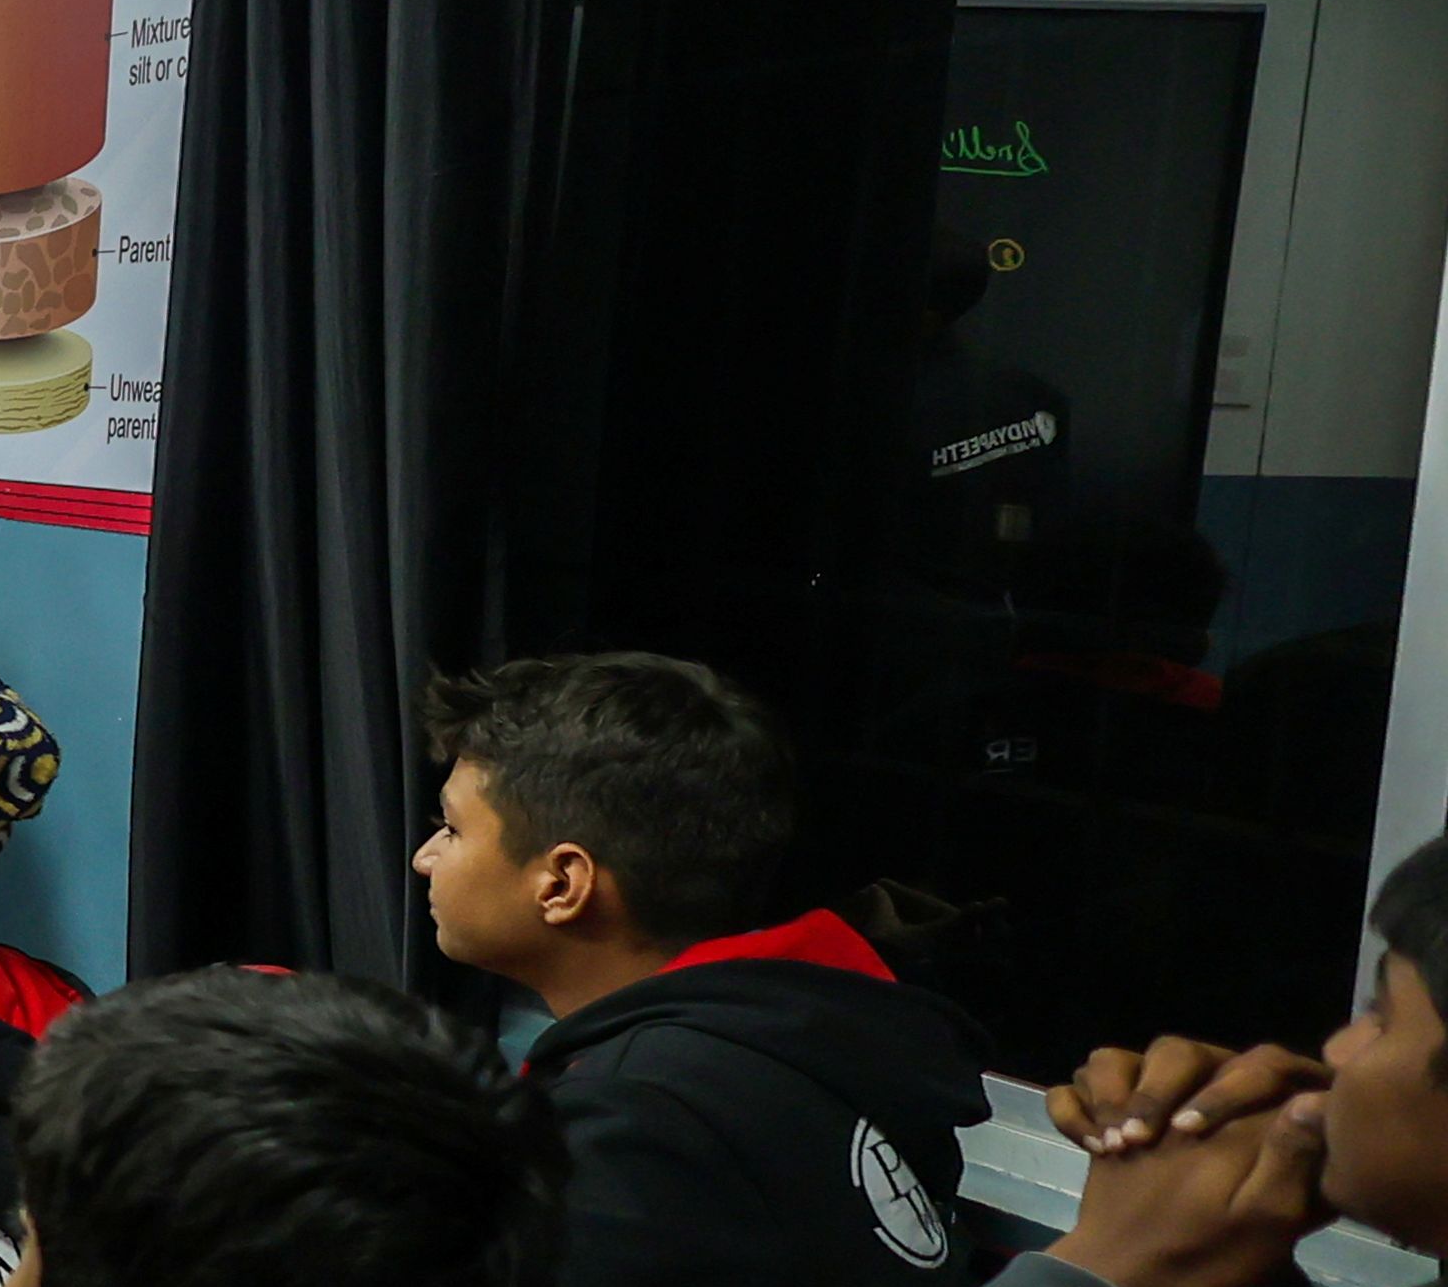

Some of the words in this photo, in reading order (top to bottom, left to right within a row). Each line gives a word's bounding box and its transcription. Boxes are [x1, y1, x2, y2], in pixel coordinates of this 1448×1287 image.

[131, 15, 191, 49] Mixture
[129, 55, 151, 86] silt
[155, 57, 173, 82] or
[119, 233, 171, 264] Parent
[110, 373, 162, 403] Unwea
[107, 412, 157, 444] parent
